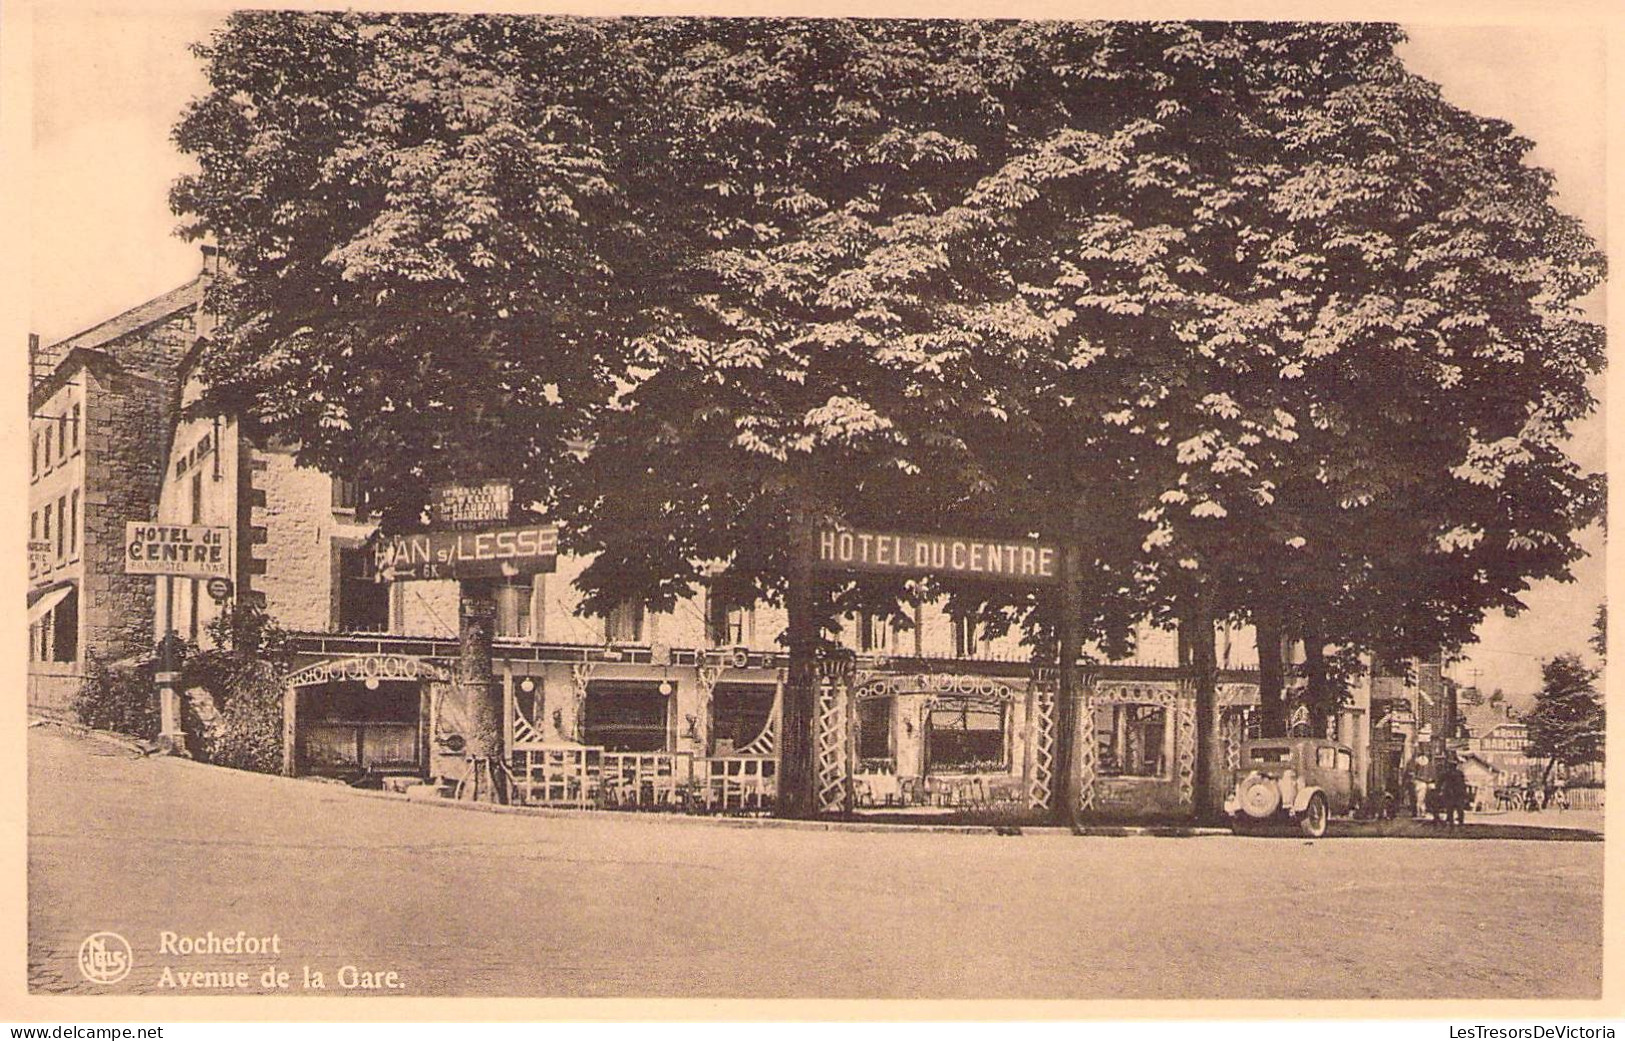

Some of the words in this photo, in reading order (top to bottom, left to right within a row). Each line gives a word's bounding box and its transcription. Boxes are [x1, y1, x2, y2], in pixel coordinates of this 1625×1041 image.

[135, 527, 194, 544] HOTEL
[202, 529, 222, 545] du
[128, 540, 223, 563] CENTRE
[914, 541, 946, 569] DU
[950, 541, 1054, 578] CENTRE
